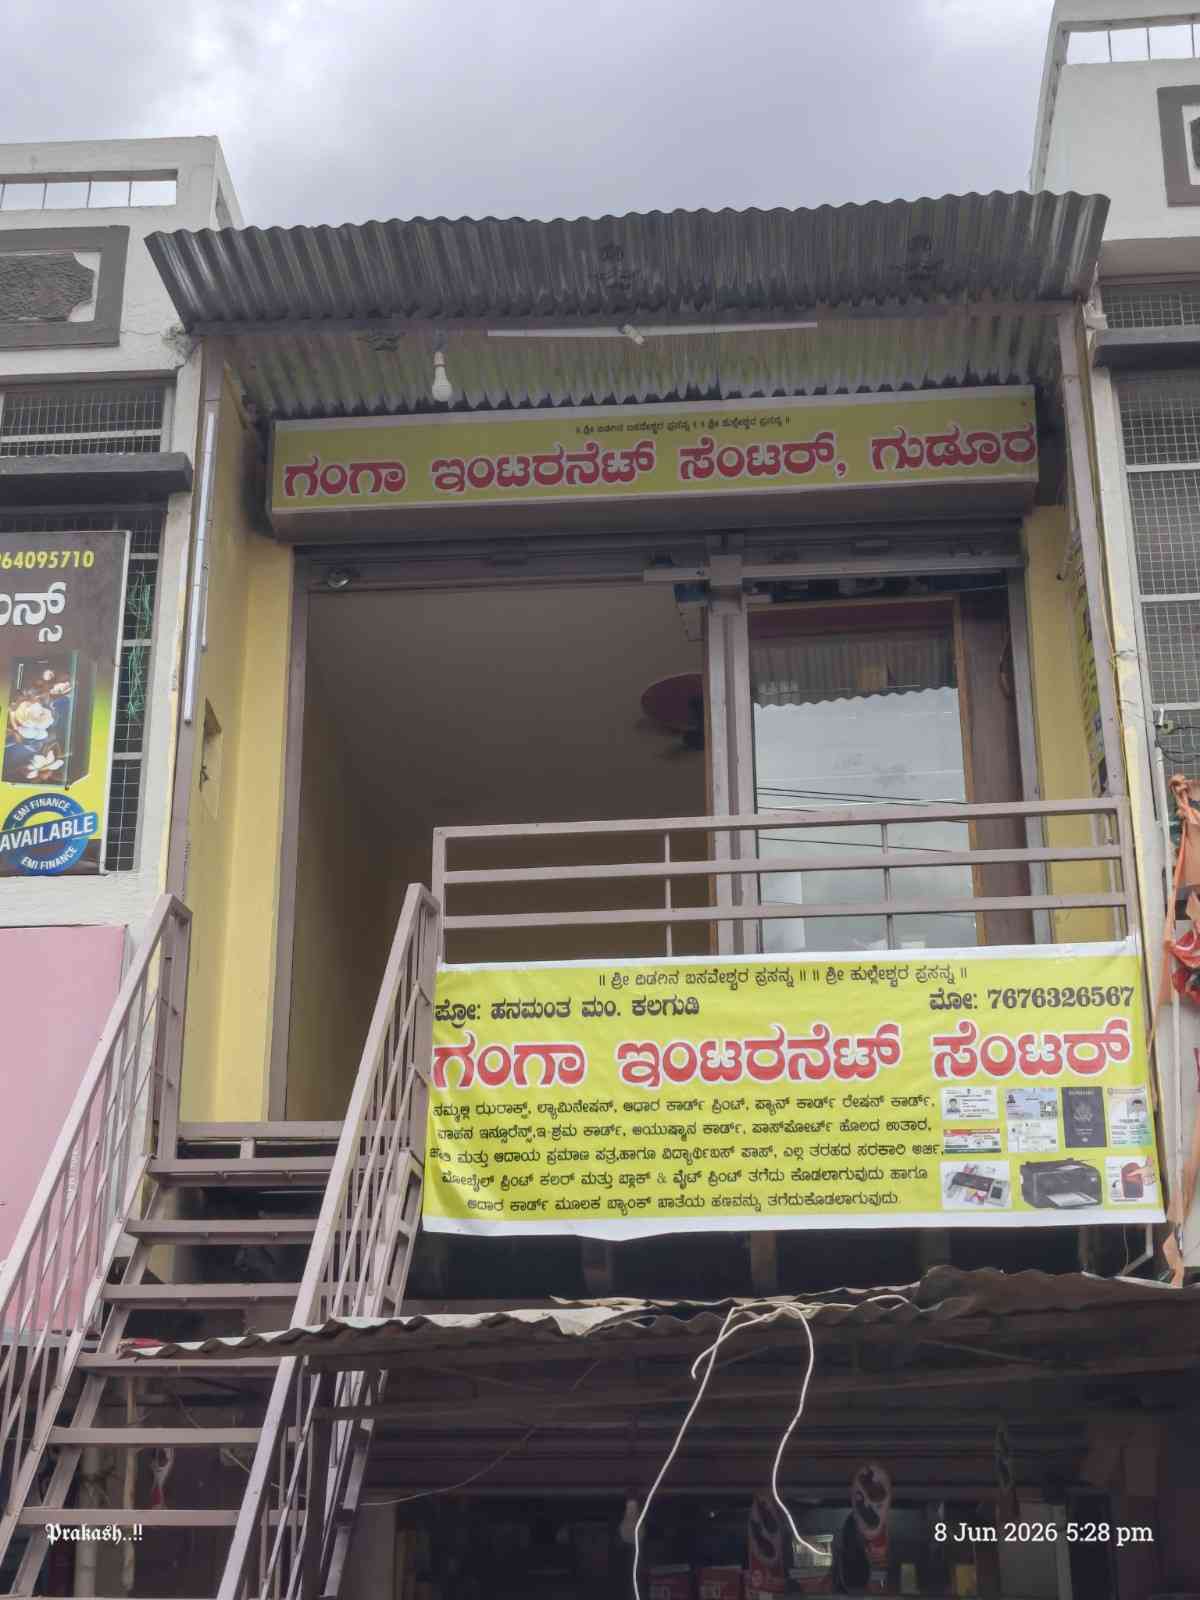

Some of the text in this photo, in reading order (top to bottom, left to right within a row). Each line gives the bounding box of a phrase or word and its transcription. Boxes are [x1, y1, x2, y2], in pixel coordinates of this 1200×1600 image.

[284, 456, 407, 497] ಗಂಗಾ
[431, 440, 655, 493] ಇಂಟರನೆಟ್
[679, 431, 848, 480] ಸೆಂಟರ್,
[0, 550, 95, 569] 64095710
[30, 797, 71, 812] FINANCE
[0, 815, 94, 852] AVAILABLE
[39, 846, 77, 870] FINANCE
[491, 996, 572, 1020] ಹನಮಂತ
[631, 994, 700, 1017] ಕಲಗುಡಿ
[988, 986, 1134, 1010] 7676326567
[432, 1019, 1131, 1088] ಗಂಗಾ ಇಂಟರನೆಟ್ ಸೆಂಟರ್
